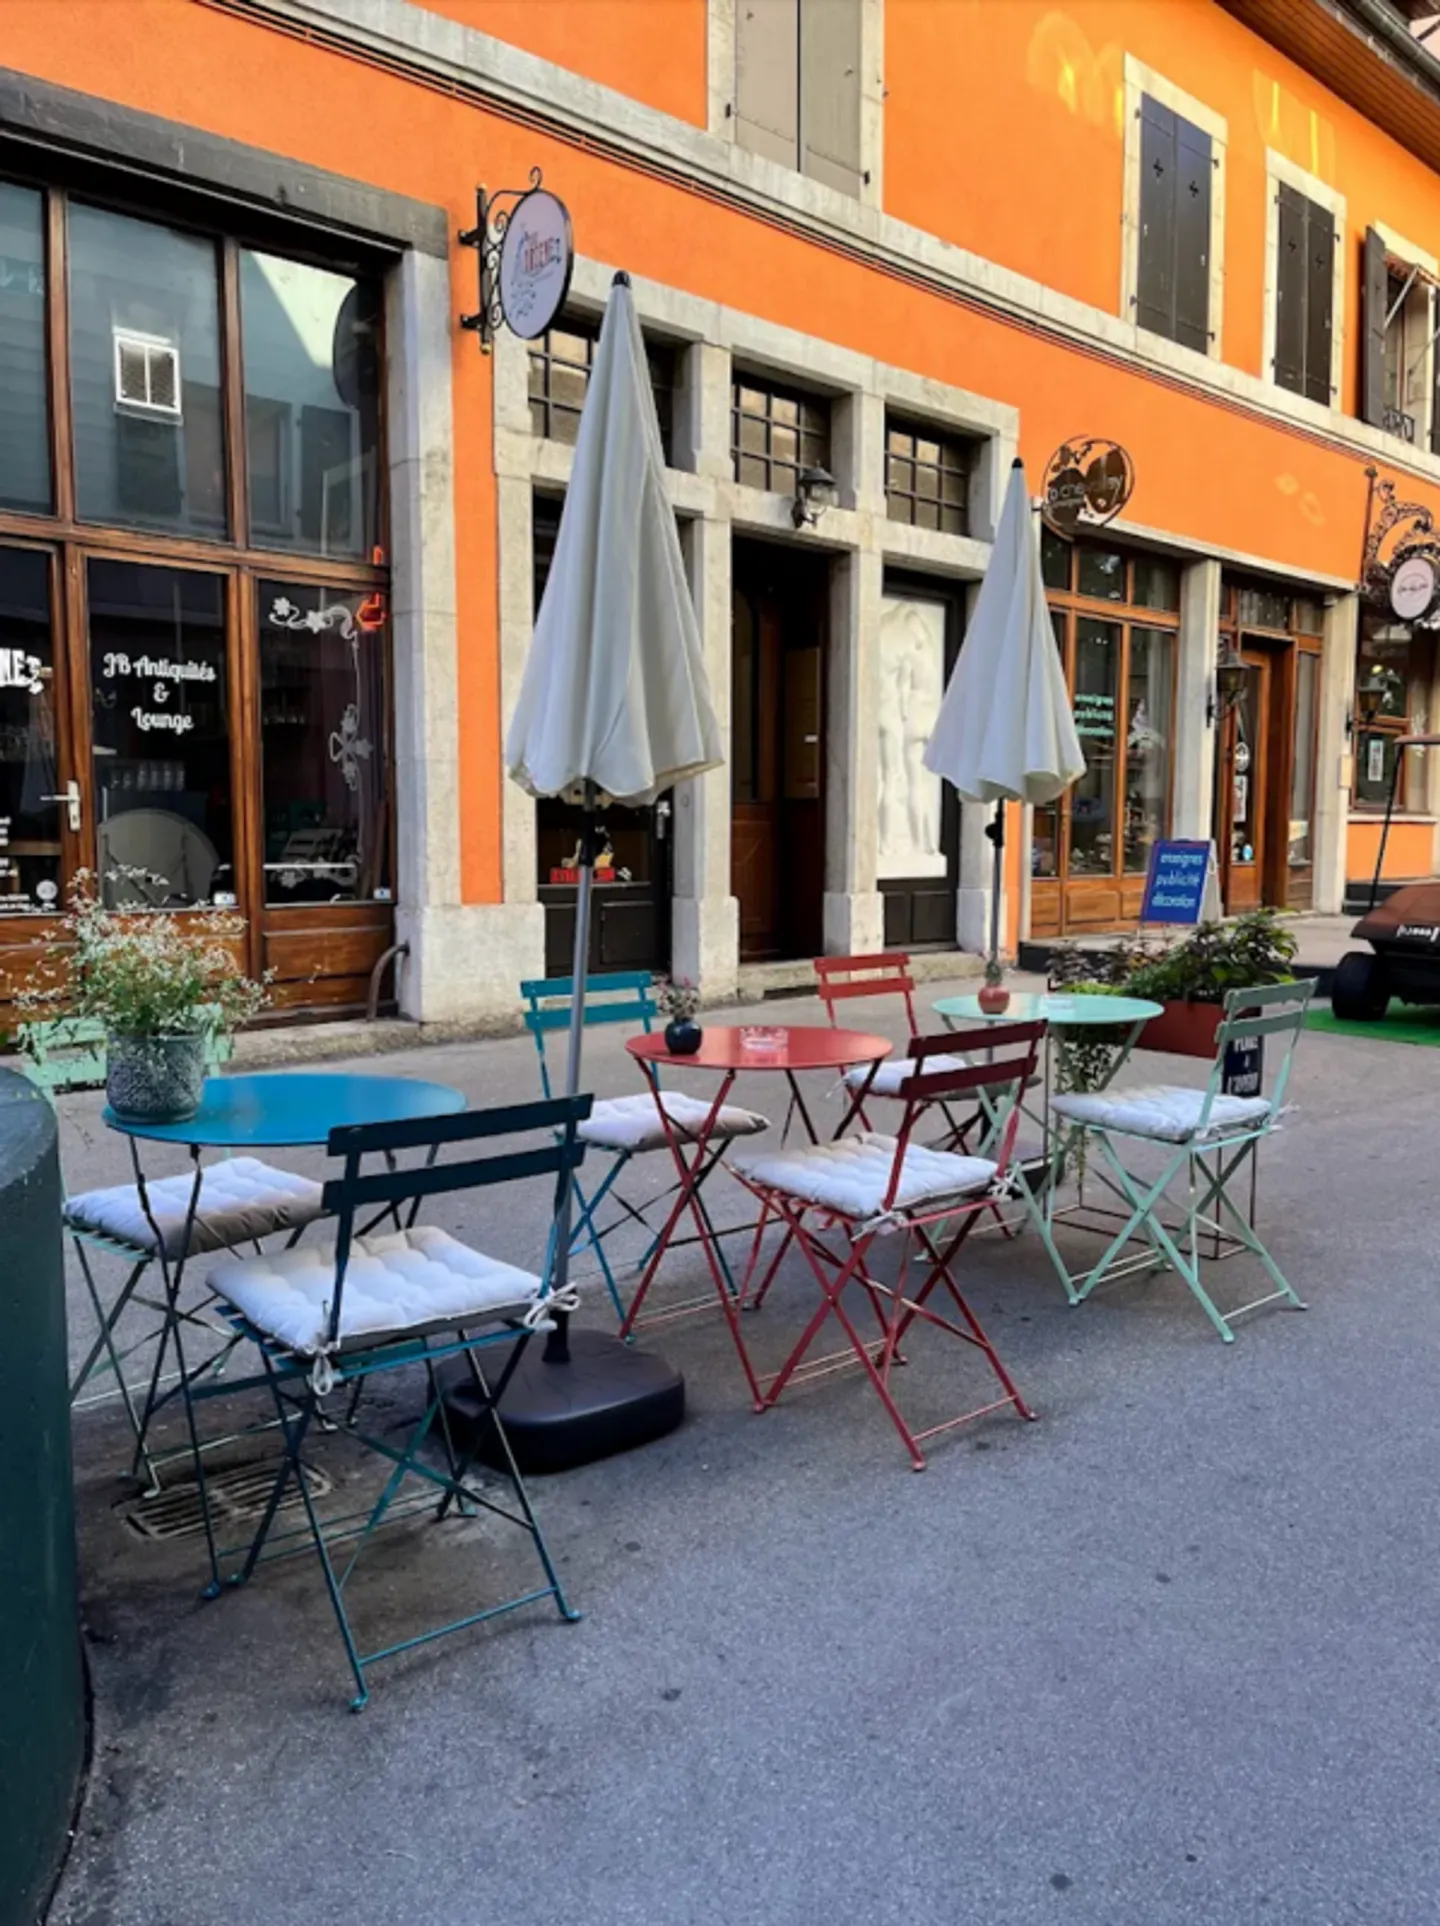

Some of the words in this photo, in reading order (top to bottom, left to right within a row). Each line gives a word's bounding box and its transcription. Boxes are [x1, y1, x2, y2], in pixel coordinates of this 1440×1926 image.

[103, 652, 131, 678] JB
[132, 655, 217, 684] Antiquités
[153, 681, 170, 703] &
[130, 706, 195, 735] Lounge
